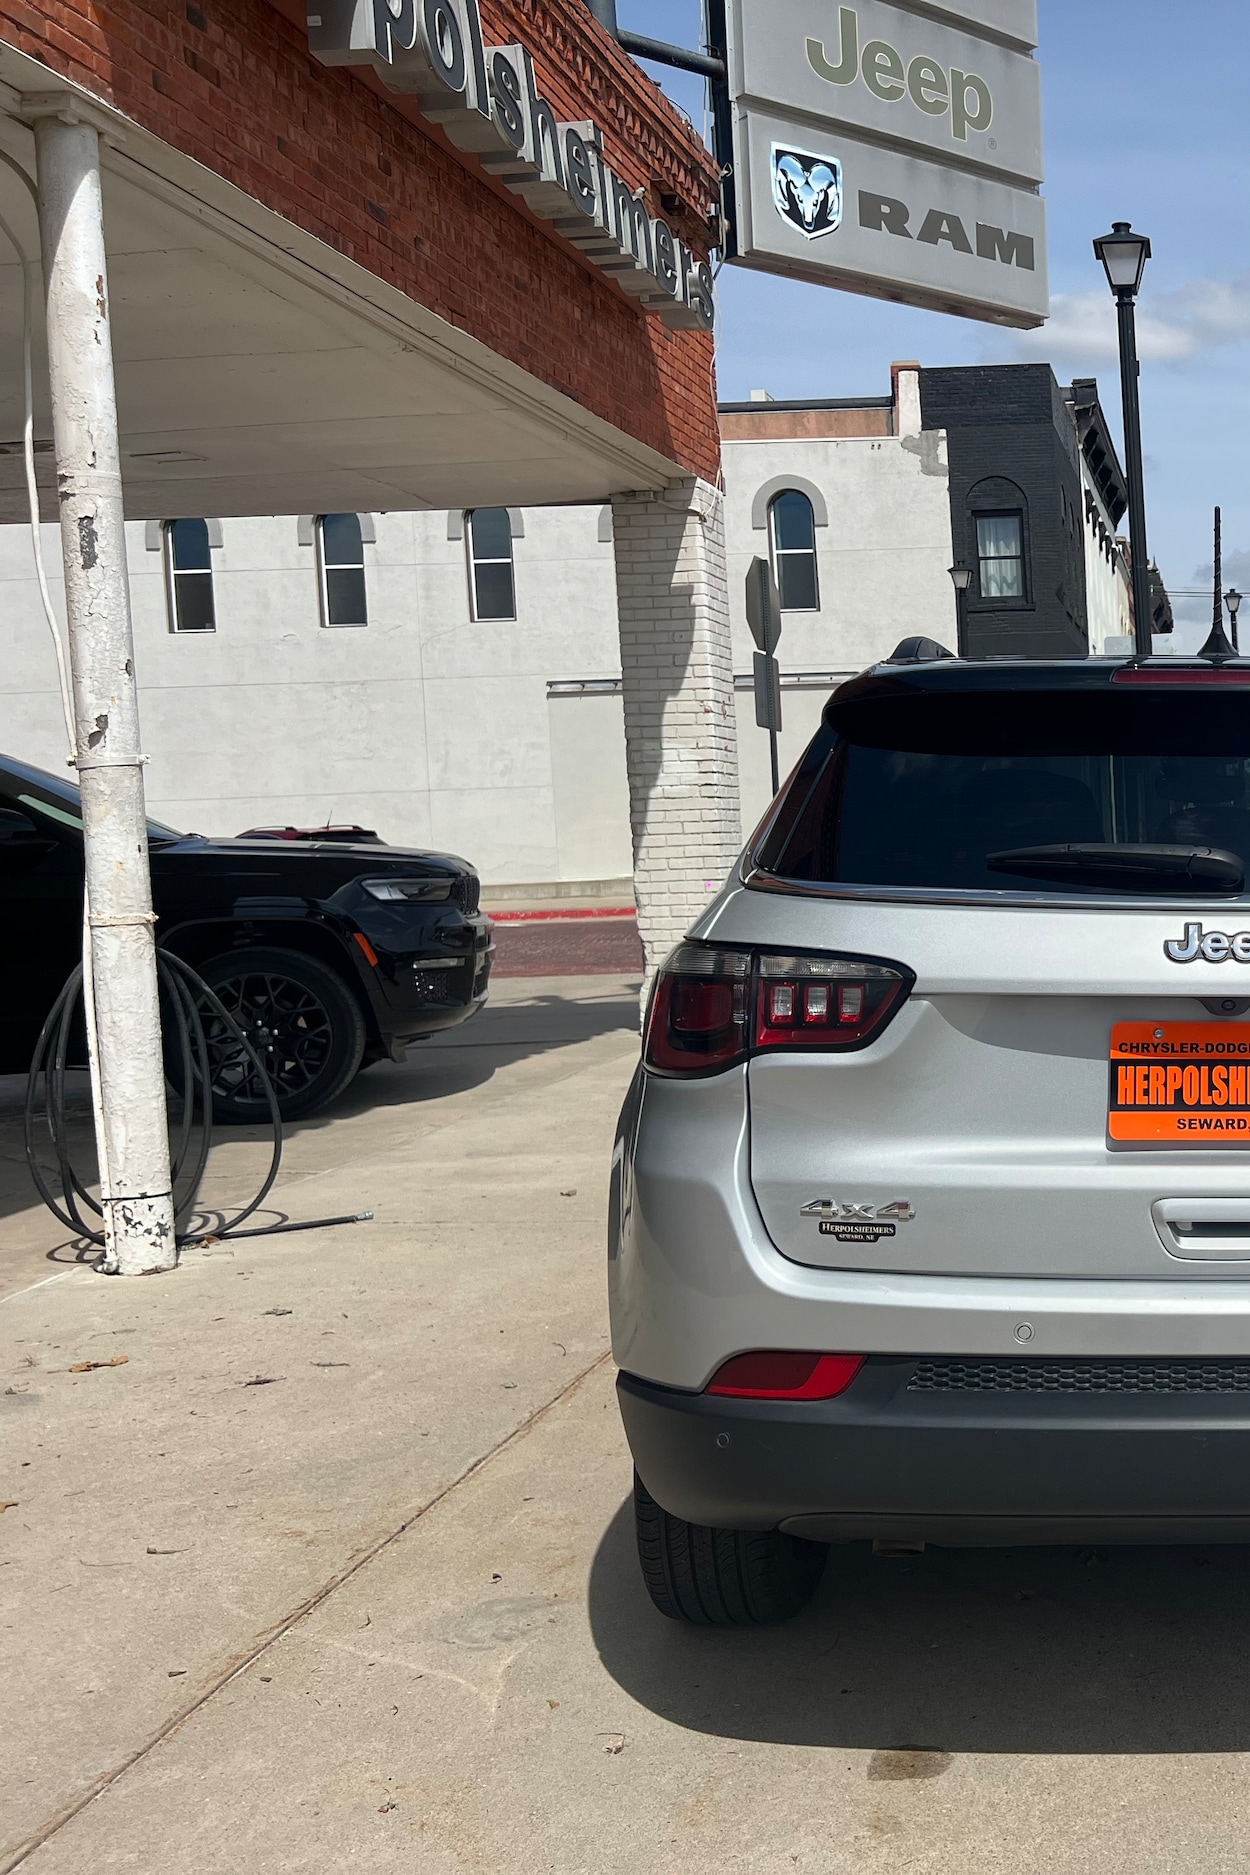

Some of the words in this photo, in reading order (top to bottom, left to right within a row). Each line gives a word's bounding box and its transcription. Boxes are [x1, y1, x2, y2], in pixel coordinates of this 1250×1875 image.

[806, 6, 993, 142] Jeep
[857, 189, 1035, 272] RAM
[800, 1199, 916, 1222] 4x4
